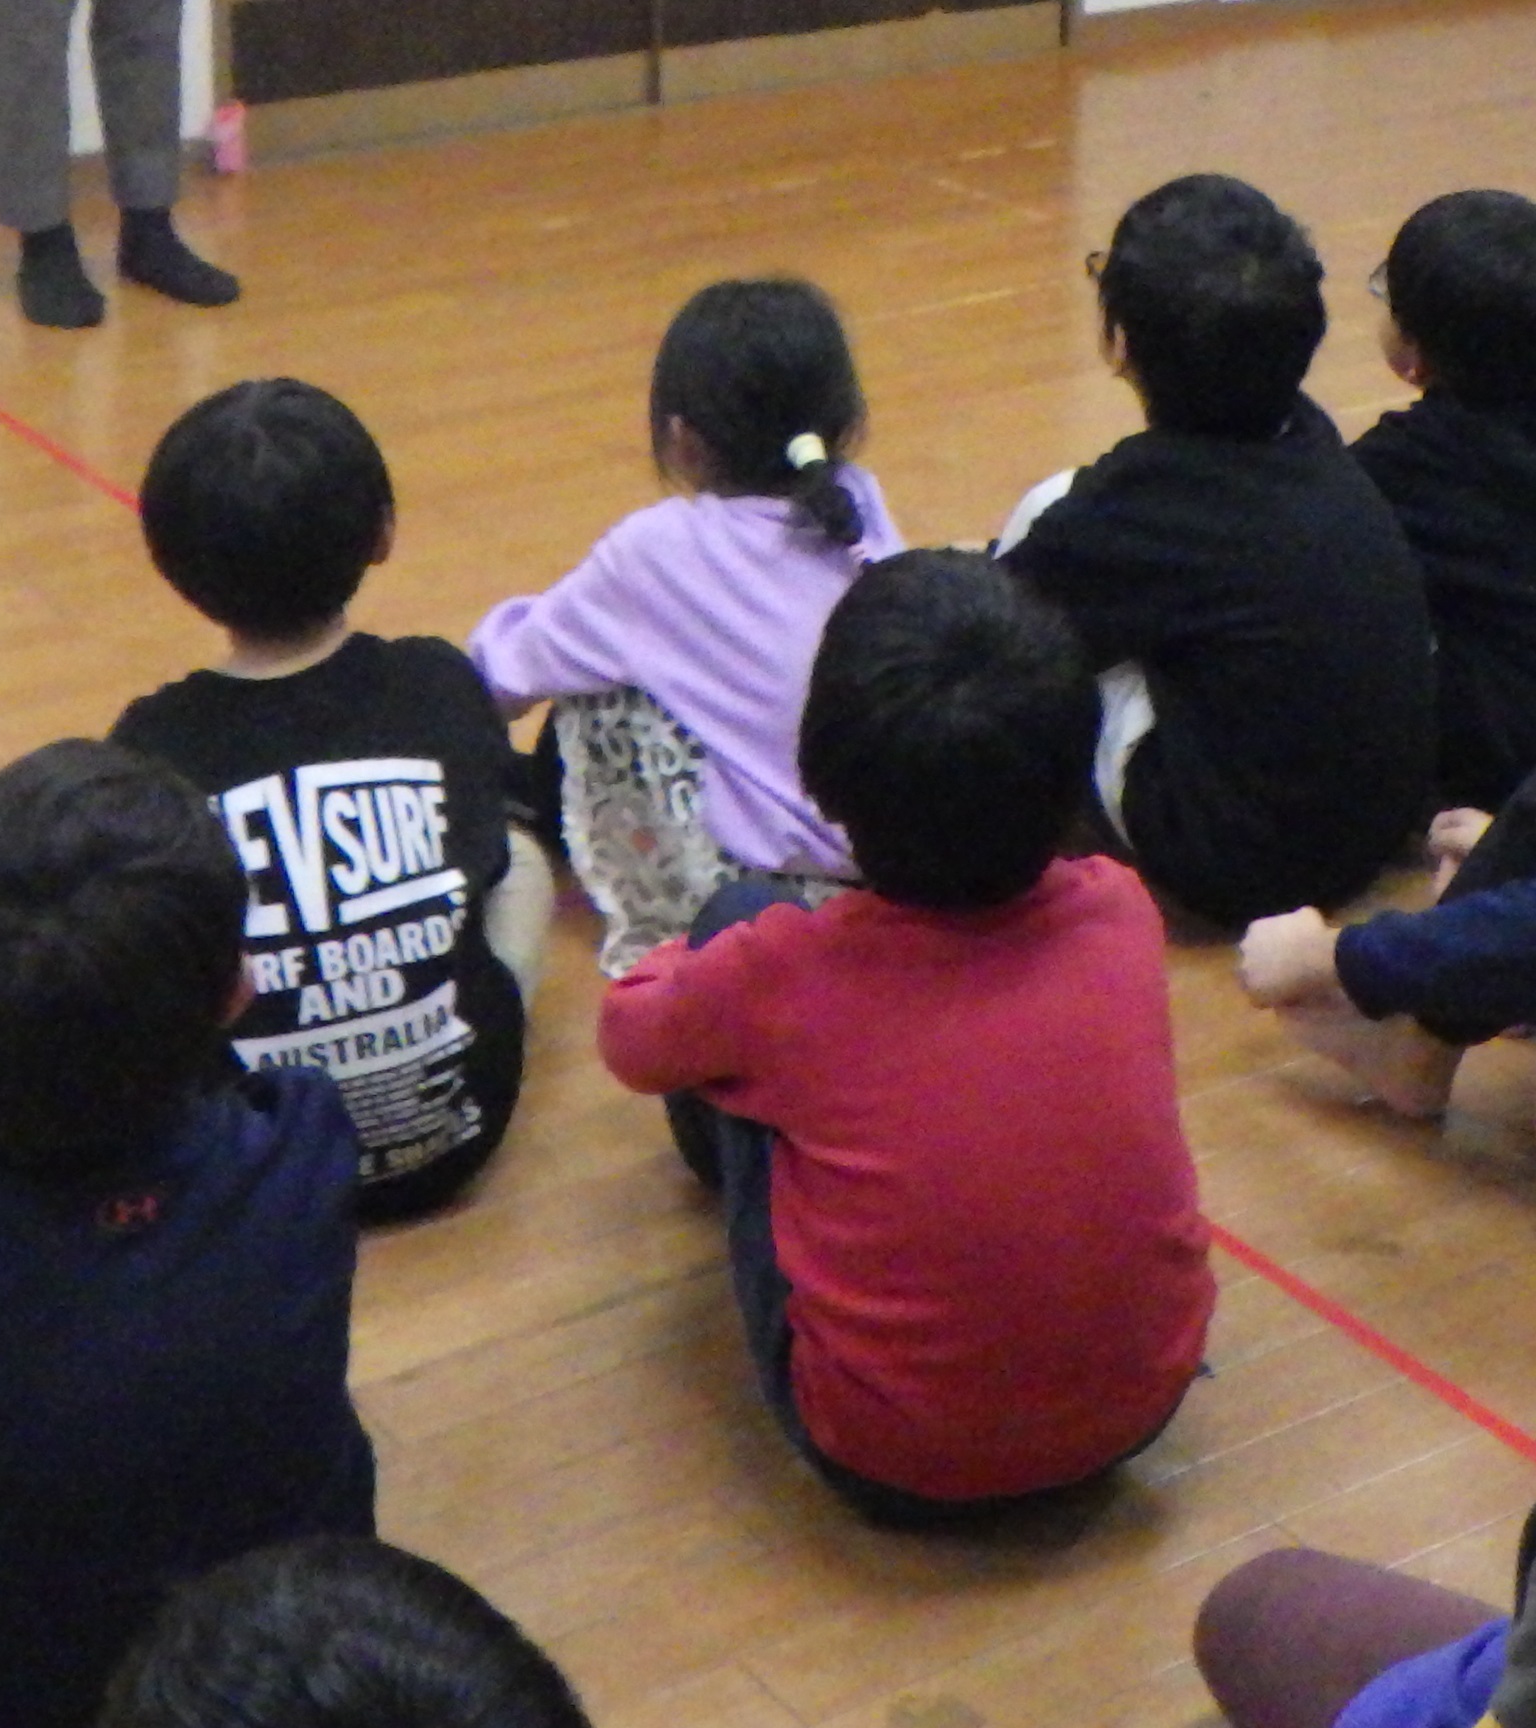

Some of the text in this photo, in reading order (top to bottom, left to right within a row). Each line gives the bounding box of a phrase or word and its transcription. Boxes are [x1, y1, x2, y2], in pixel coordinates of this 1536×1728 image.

[323, 783, 449, 895] SURF
[298, 969, 407, 1026] AND
[259, 1004, 449, 1069] AUSTRALIA
